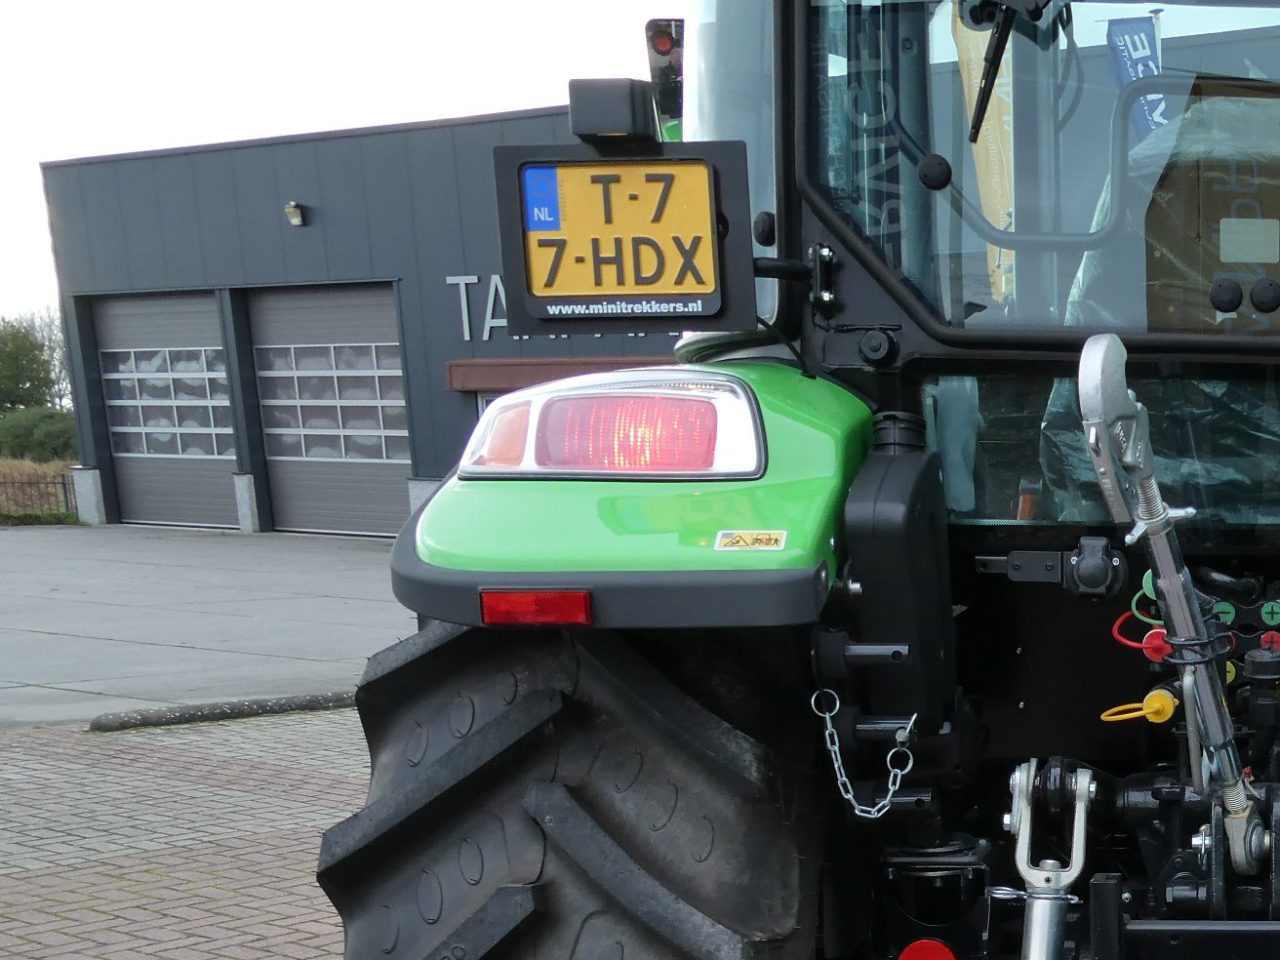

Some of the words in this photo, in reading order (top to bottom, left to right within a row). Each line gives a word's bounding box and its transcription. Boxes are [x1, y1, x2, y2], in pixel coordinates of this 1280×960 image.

[533, 207, 554, 222] NL
[590, 173, 675, 225] T-7
[537, 235, 706, 289] 7-HDX
[547, 299, 703, 316] www.minitrekkers.nl
